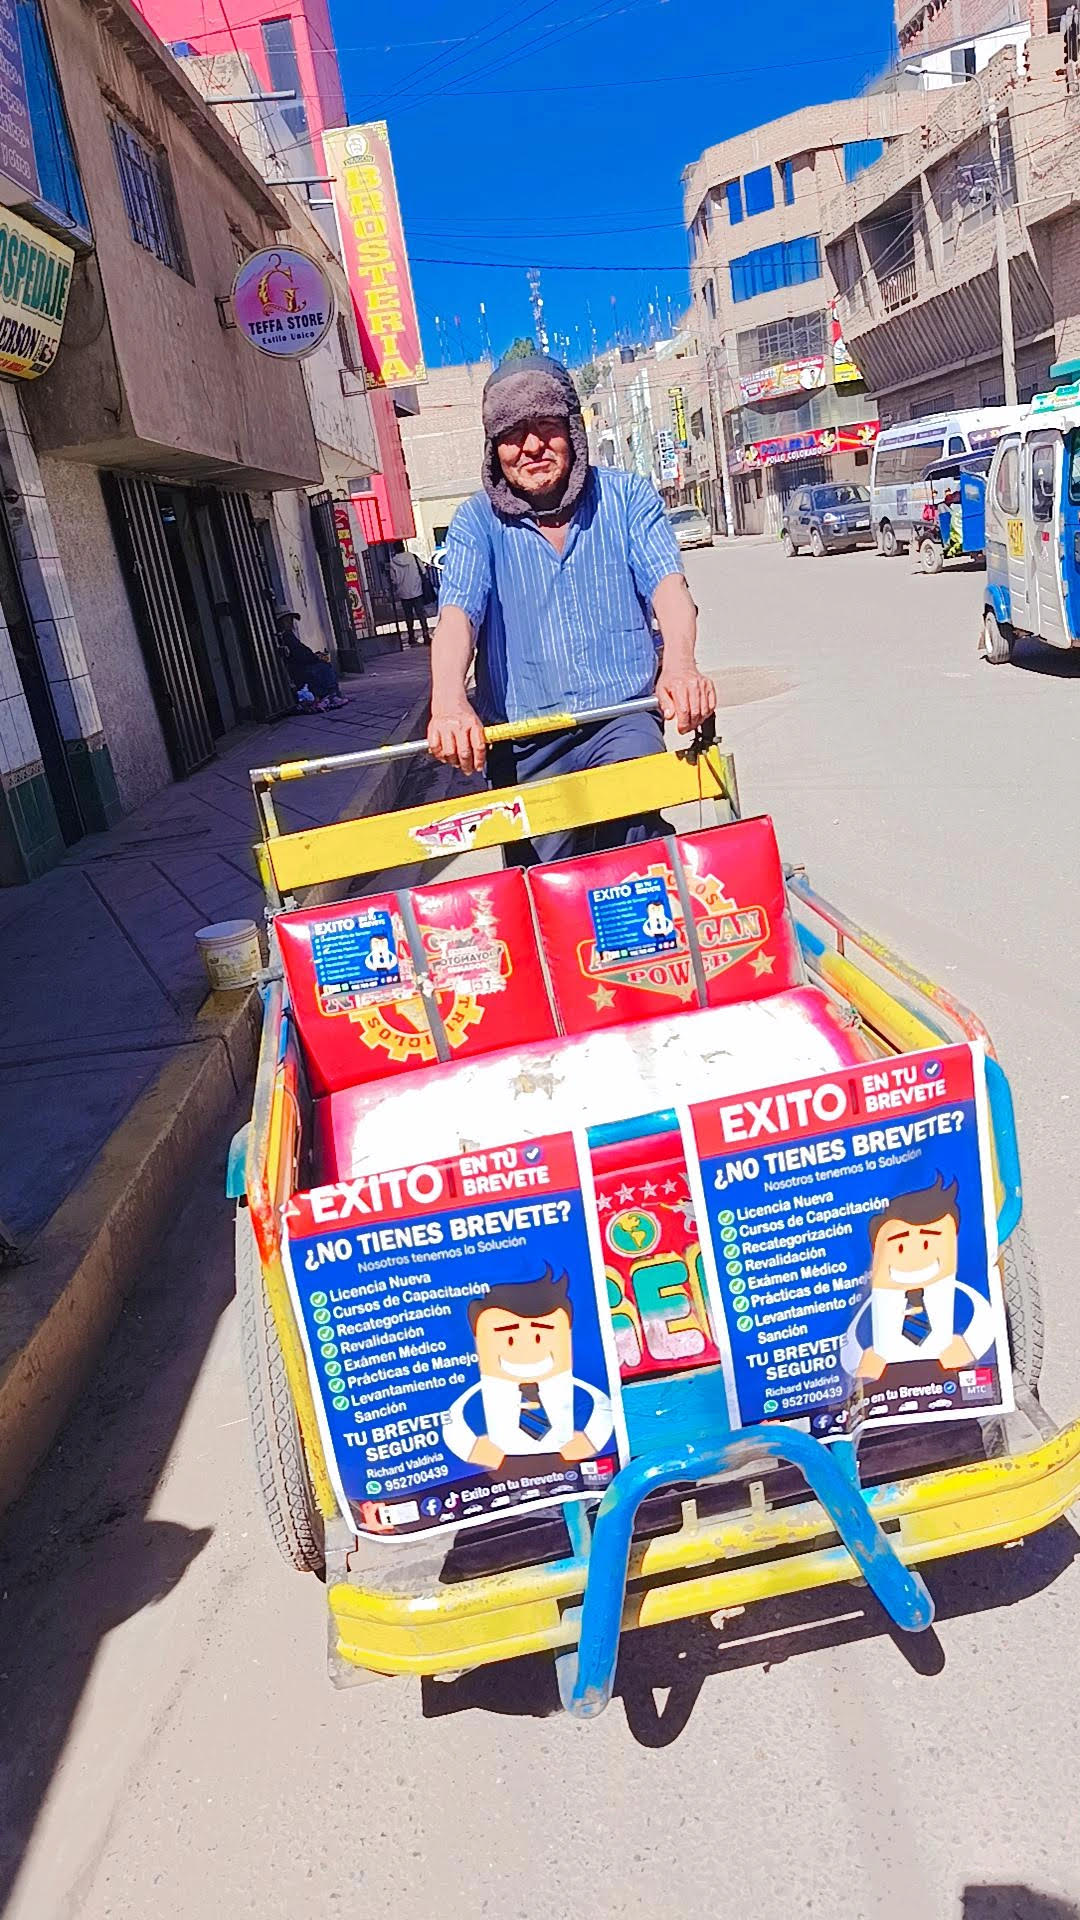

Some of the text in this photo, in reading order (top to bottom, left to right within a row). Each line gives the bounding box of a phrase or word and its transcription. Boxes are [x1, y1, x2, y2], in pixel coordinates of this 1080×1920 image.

[344, 166, 414, 381] BROSTERIA
[248, 312, 325, 335] TEFFA STORE
[593, 885, 632, 902] EXITO
[314, 918, 355, 936] EXITO
[862, 1066, 917, 1094] EN TU
[865, 1079, 946, 1112] BREVETE
[719, 1083, 847, 1143] EXITO
[459, 1147, 518, 1177] EN TU
[714, 1111, 965, 1190] ¿NO TIENES BREVETE?
[462, 1165, 551, 1196] BREVETE
[764, 1148, 922, 1192] Nosotros tenemos la Solución
[309, 1163, 444, 1224] EXITO
[736, 1191, 834, 1221] Licencia Nueva
[739, 1197, 889, 1238] Cursos de Capacitación
[304, 1200, 571, 1271] ¿NO TIENES BREVETE?
[742, 1223, 853, 1254] Recategorización
[358, 1236, 527, 1273] Nosotros tenemos la Solución
[745, 1247, 826, 1271] Revalidación
[329, 1272, 432, 1303] Licencia Nueva
[748, 1261, 847, 1289] Exámen Médico
[333, 1282, 491, 1319] Cursos de Capacitación
[751, 1284, 812, 1308] Prácticas
[813, 1282, 830, 1295] de
[336, 1304, 452, 1337] Recategorización
[755, 1297, 847, 1327] Levantamiento
[340, 1326, 424, 1354] Revalidación
[757, 1323, 808, 1344] Sanción
[344, 1341, 447, 1372] Exámen Médico
[746, 1333, 849, 1368] TU BREVETE
[347, 1352, 479, 1389] Prácticas de Manejo
[766, 1354, 837, 1380] SEGURO
[351, 1373, 466, 1406] Levantamiento de
[765, 1375, 840, 1398] Richard Valdivia
[781, 1386, 843, 1408] 952700439
[871, 1393, 885, 1404] en
[886, 1389, 898, 1400] tu
[899, 1382, 944, 1398] Brevete
[967, 1385, 987, 1394] MTC
[354, 1400, 407, 1423] Sanción
[343, 1410, 453, 1447] TU BREVETE
[365, 1431, 439, 1462] SEGURO
[366, 1452, 445, 1479] Richard Valdivia
[385, 1465, 449, 1491] 952700439
[491, 1482, 506, 1495] en
[507, 1479, 520, 1490] tu
[521, 1472, 565, 1488] Brevete
